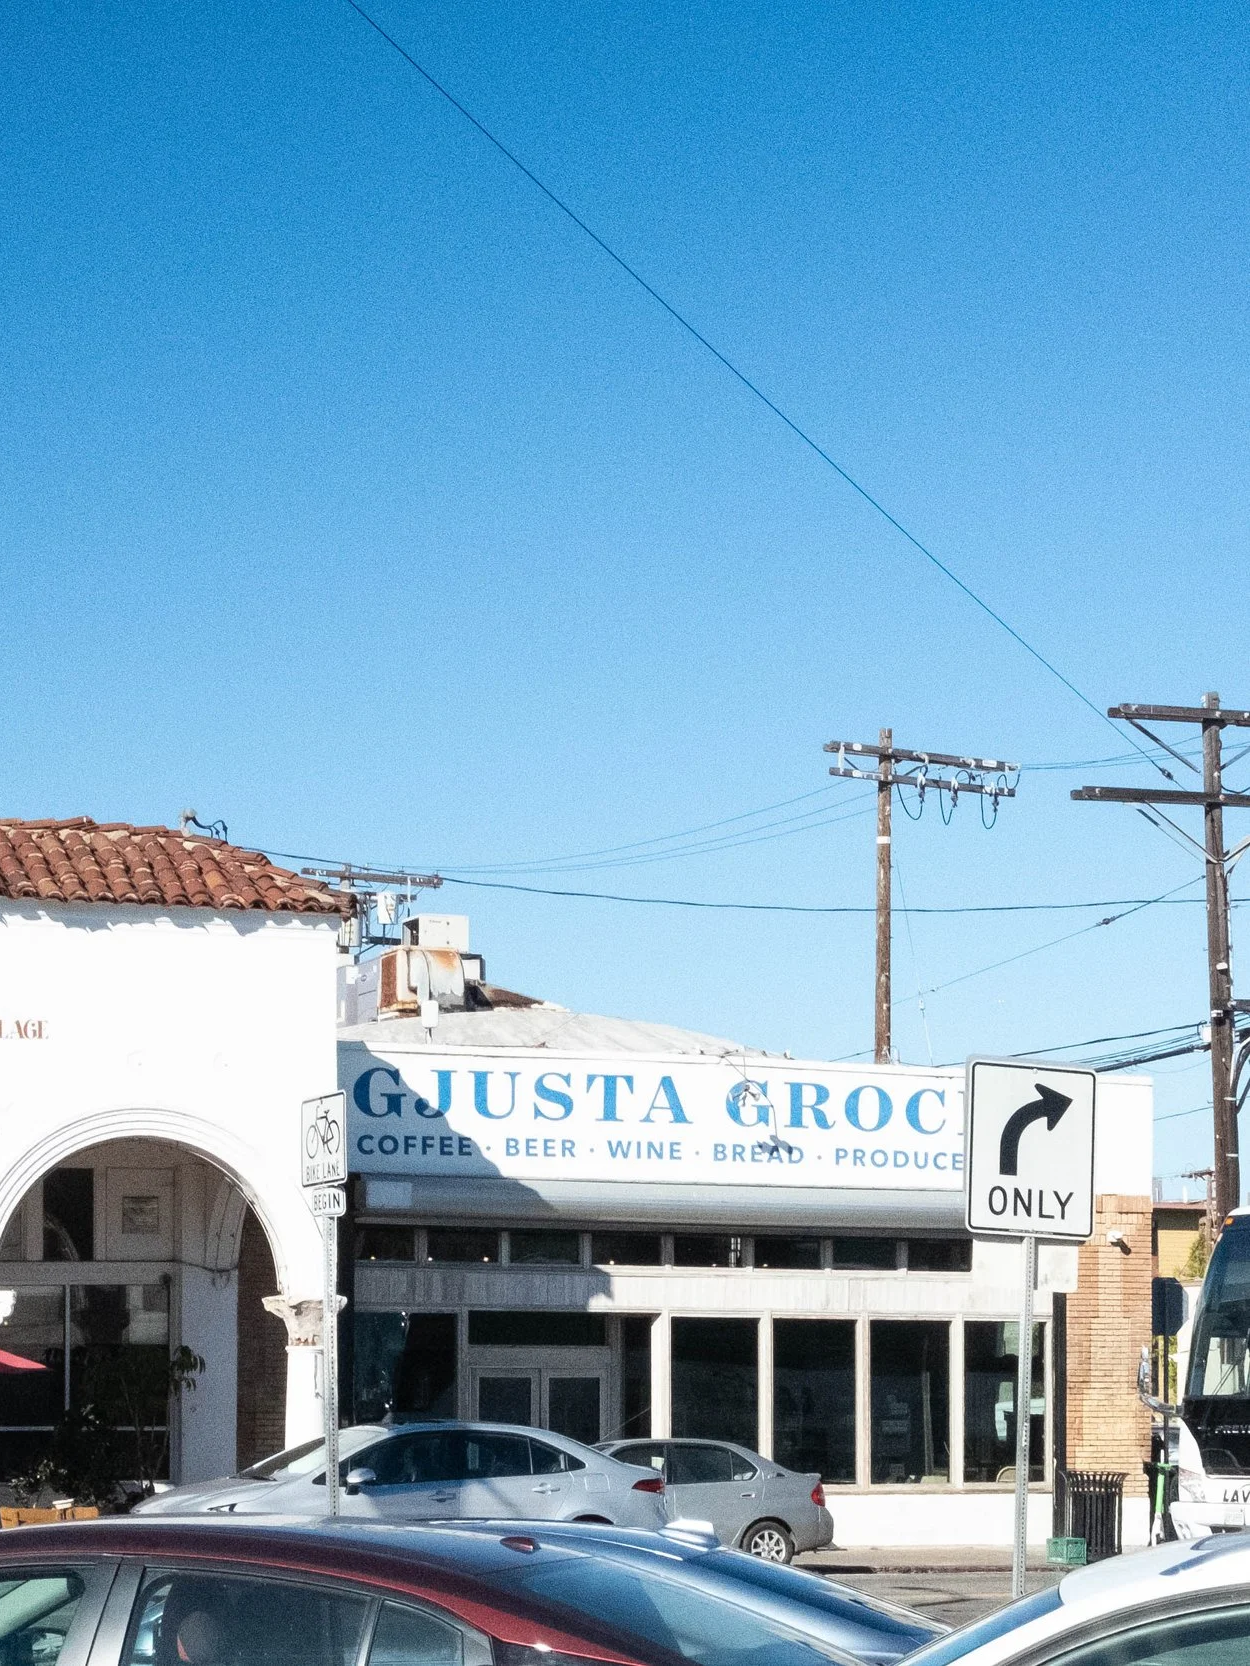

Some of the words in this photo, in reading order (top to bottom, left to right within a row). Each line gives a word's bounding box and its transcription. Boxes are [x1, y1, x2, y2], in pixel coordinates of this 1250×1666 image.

[353, 1067, 693, 1124] GJUSTA
[725, 1080, 964, 1136] GROC
[306, 1163, 320, 1182] BIKE
[322, 1157, 341, 1178] LANE
[356, 1133, 473, 1156] COFFEE
[505, 1137, 577, 1158] BEER
[607, 1139, 683, 1161] WINE
[713, 1142, 805, 1165] BREAD
[835, 1148, 964, 1171] PRODUCE
[313, 1192, 341, 1212] BEGIN
[988, 1185, 1075, 1221] ONLY
